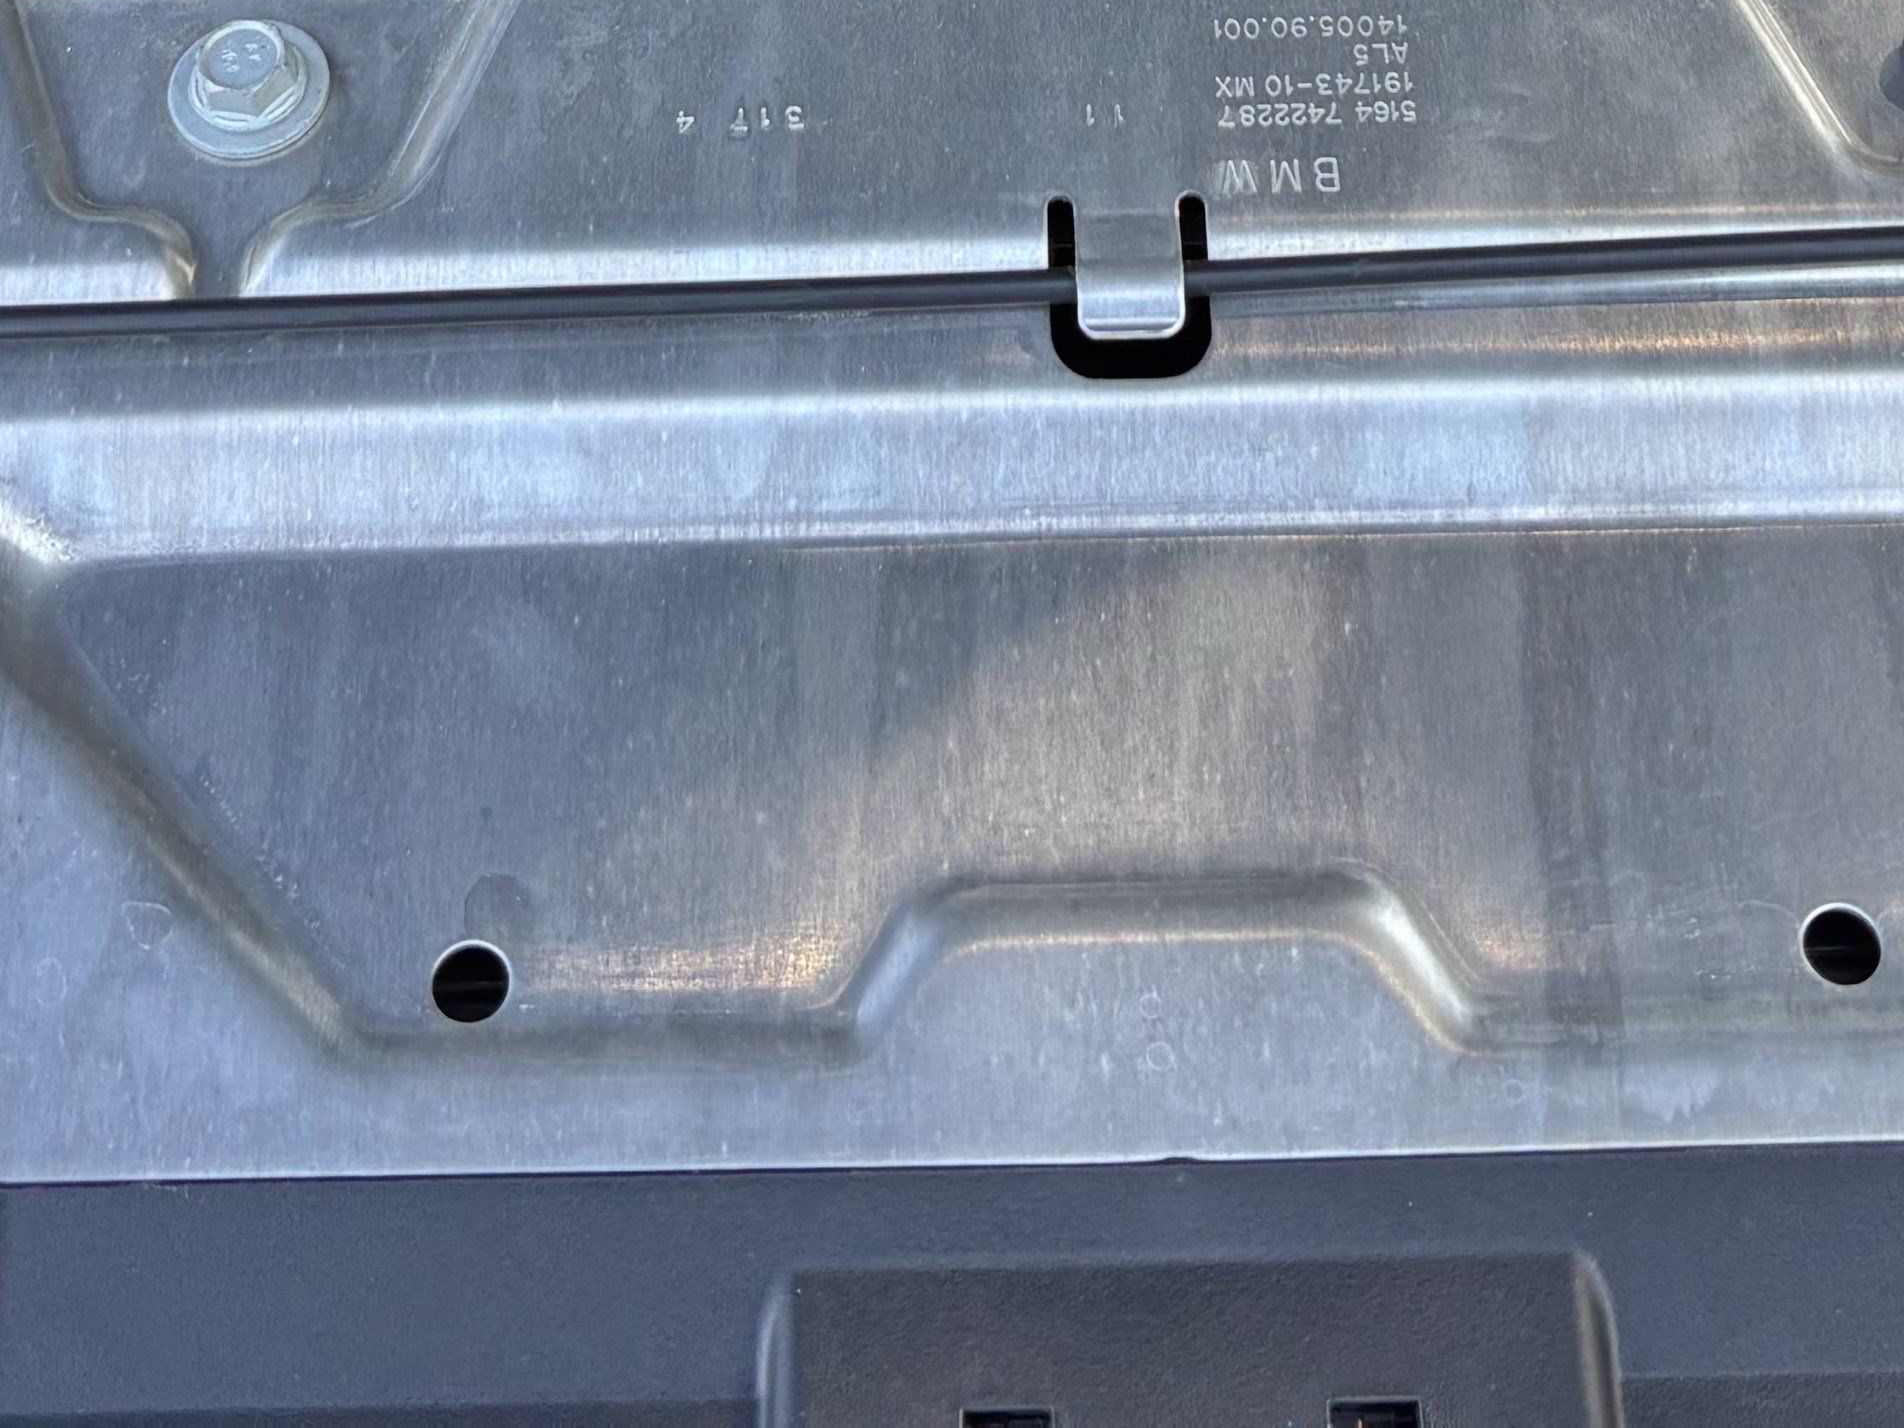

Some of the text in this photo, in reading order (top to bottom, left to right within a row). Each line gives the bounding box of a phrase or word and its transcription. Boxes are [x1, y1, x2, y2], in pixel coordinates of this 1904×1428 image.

[1214, 15, 1408, 41] 14005.90.001
[1215, 71, 1413, 99] 191743-10 MX
[1218, 100, 1417, 129] 5164 7422287
